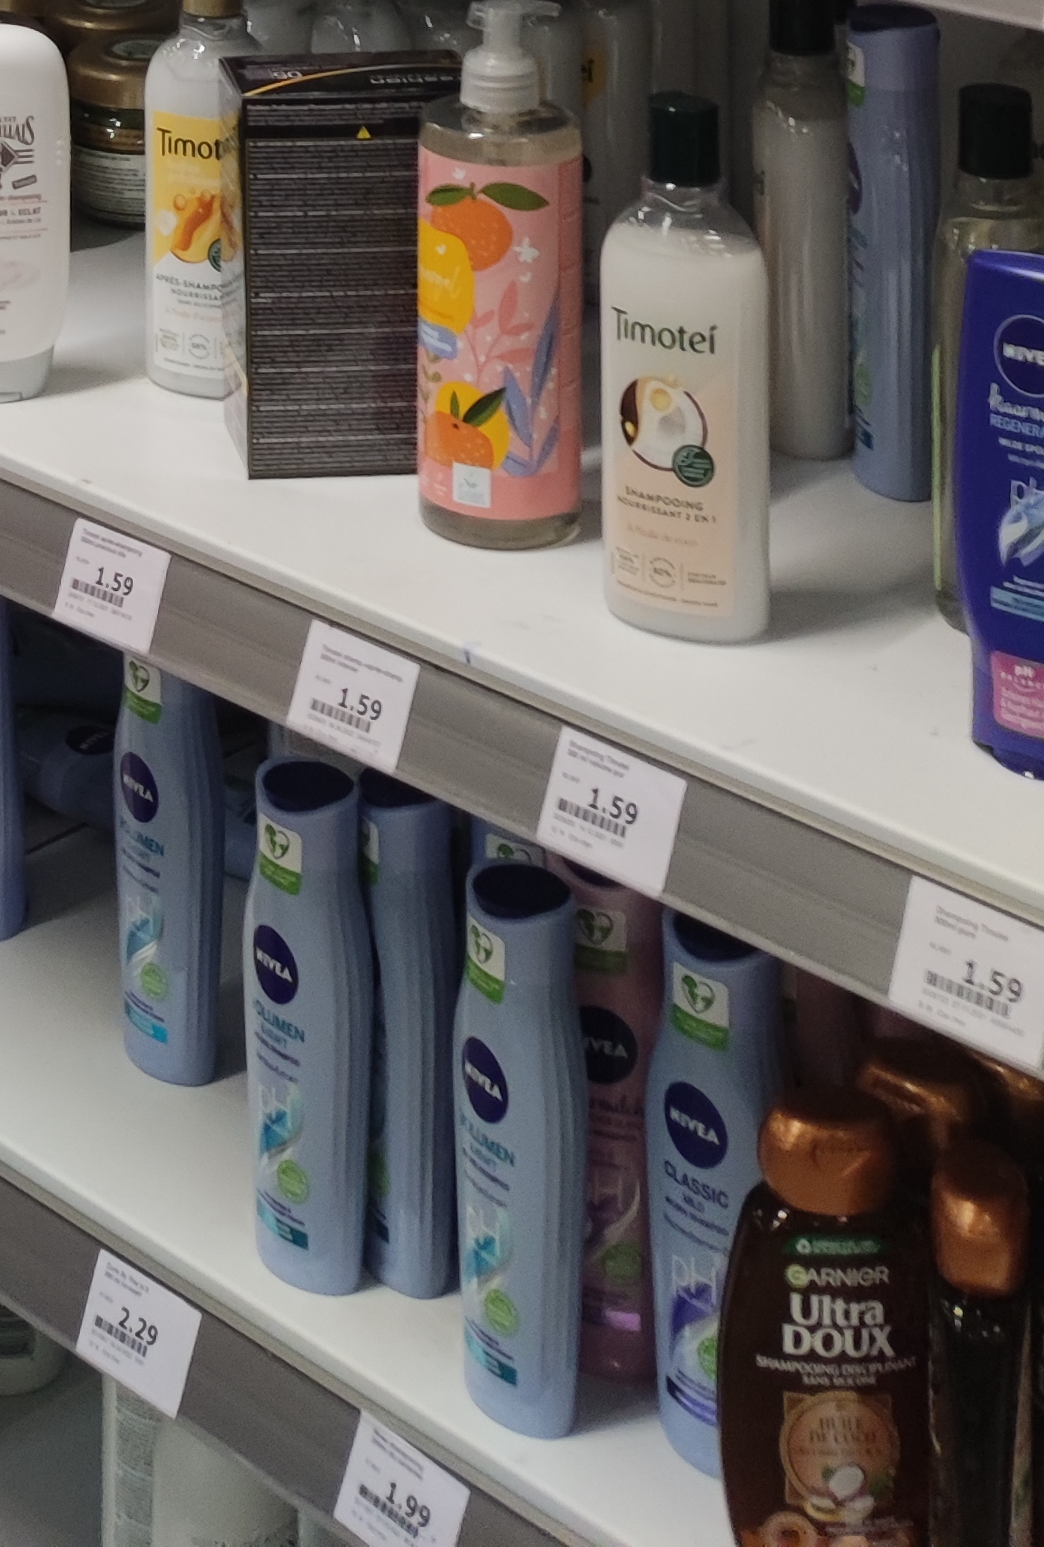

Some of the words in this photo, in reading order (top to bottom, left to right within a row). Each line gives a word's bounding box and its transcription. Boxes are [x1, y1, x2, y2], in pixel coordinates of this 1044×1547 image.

[156, 126, 221, 161] Timot
[610, 305, 718, 355] Timotei
[1002, 341, 1044, 367] NIVE
[625, 485, 704, 512] SHAMPOOING
[96, 565, 135, 598] 1.59
[336, 687, 383, 722] 1.59
[588, 787, 639, 826] 1.59
[256, 947, 293, 983] NIVEA
[962, 958, 1024, 1004] 1.59
[463, 1058, 504, 1103] NIVEA
[669, 1105, 720, 1147] NIVEA
[664, 1159, 729, 1209] CLASSIC
[785, 1263, 890, 1289] GARNIER
[119, 1307, 160, 1346] 2.29
[789, 1291, 885, 1327] Ultra
[781, 1322, 896, 1358] DOUX
[756, 1353, 840, 1376] SHAMPOOING
[384, 1482, 432, 1529] 1.99
